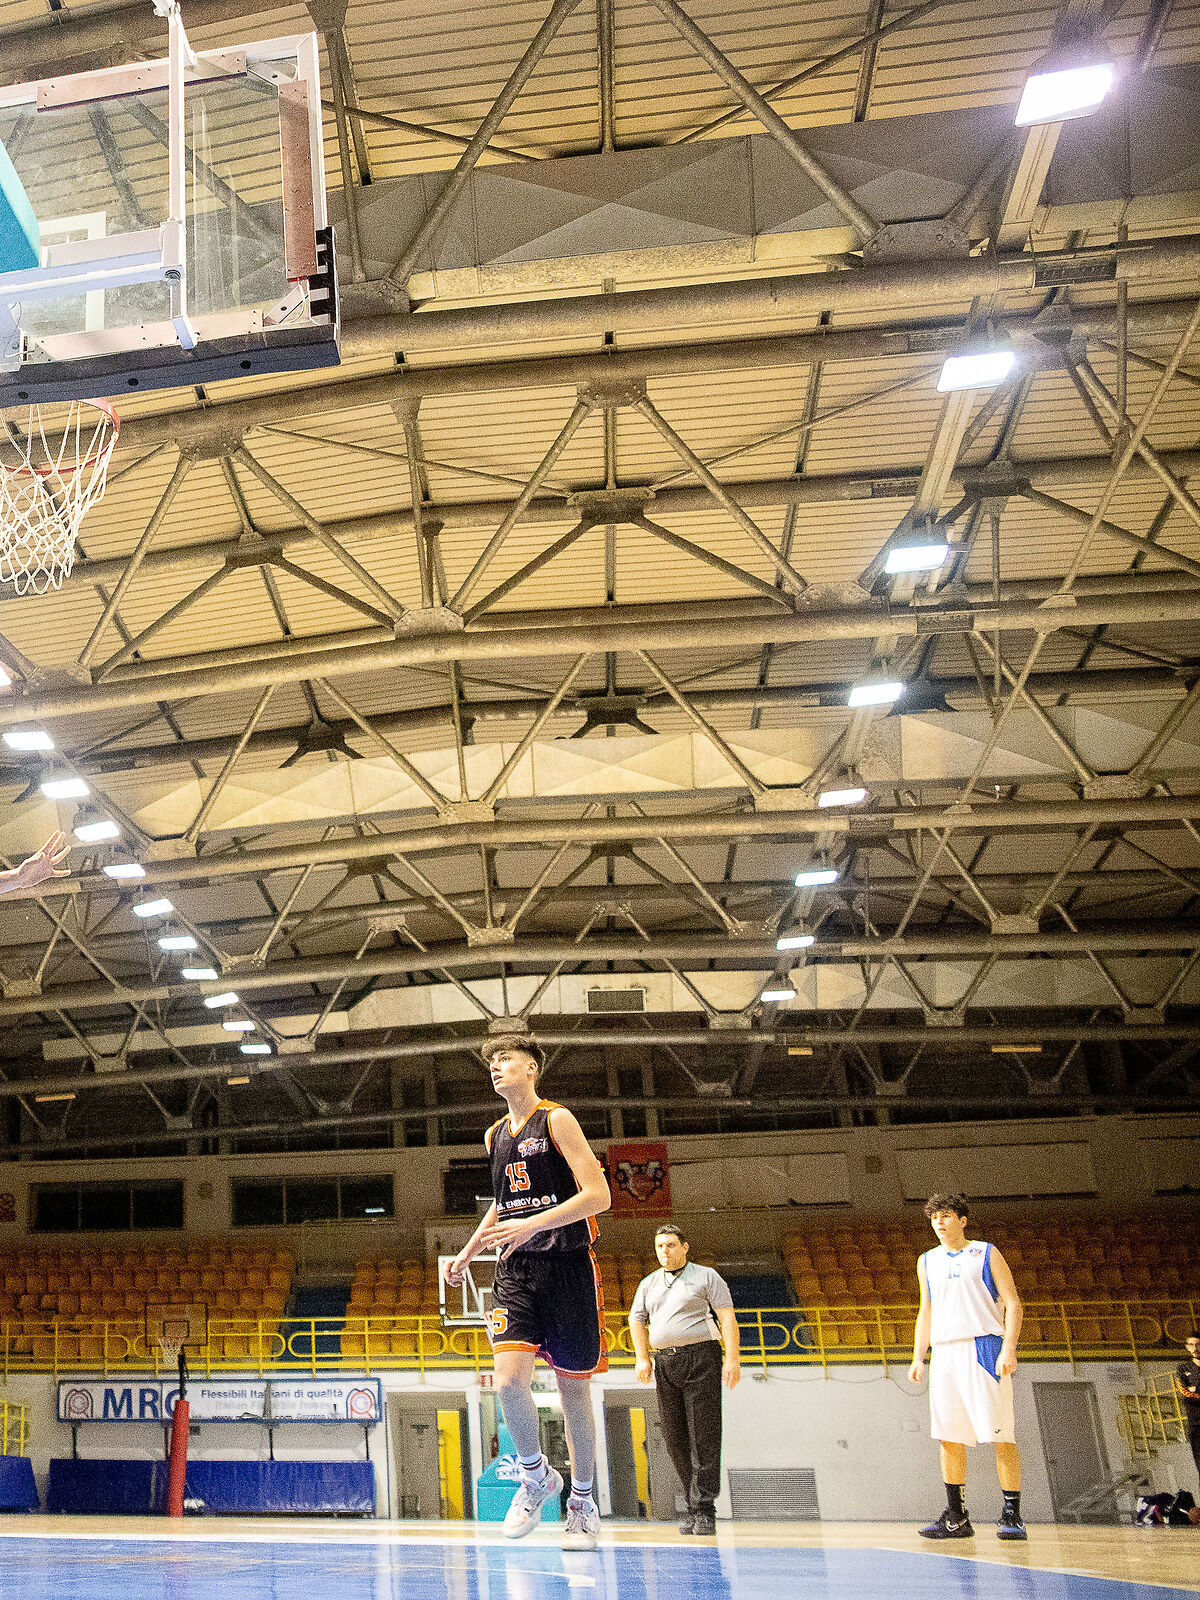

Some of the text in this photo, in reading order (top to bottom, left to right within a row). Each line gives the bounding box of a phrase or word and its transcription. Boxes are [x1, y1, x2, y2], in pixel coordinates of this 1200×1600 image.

[505, 1161, 531, 1193] 15
[200, 1389, 247, 1399] Flessibili
[294, 1389, 303, 1399] di
